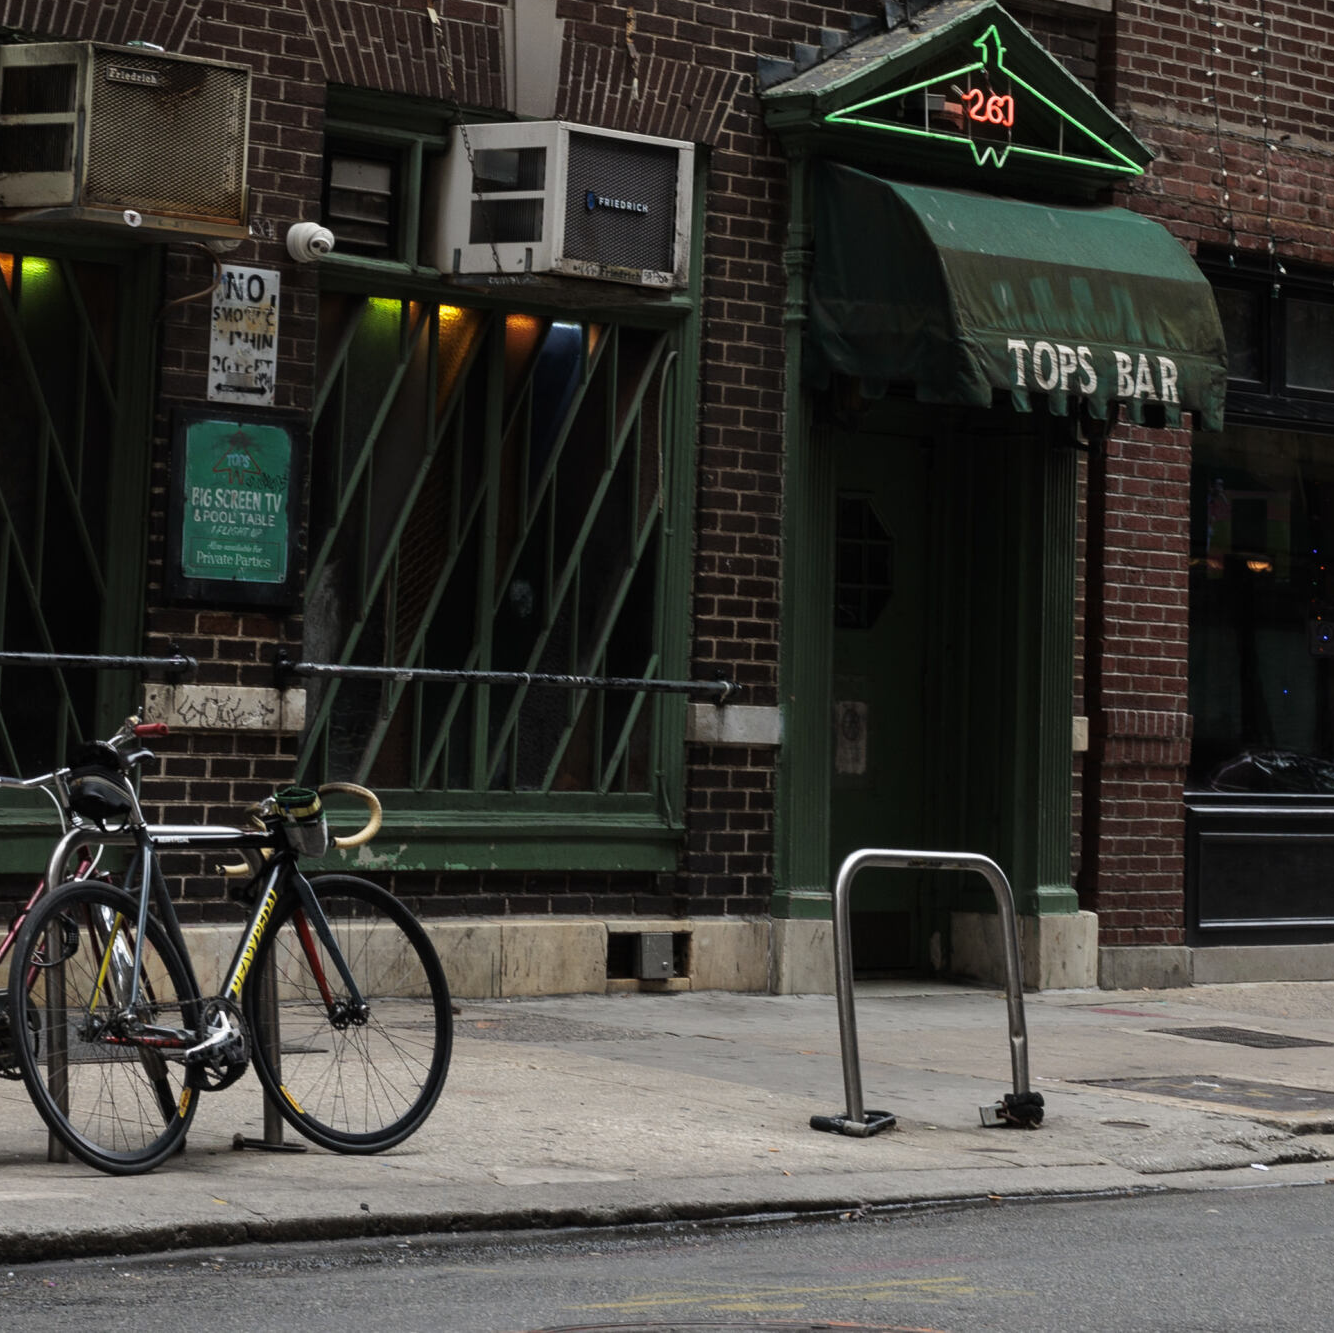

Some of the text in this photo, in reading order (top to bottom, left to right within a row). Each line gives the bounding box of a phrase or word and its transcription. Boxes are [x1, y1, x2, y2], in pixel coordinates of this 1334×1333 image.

[598, 197, 649, 213] FRIEDRICH
[226, 271, 265, 303] NO
[1006, 337, 1181, 405] TOPS BAR
[227, 453, 251, 468] TOPS
[191, 486, 282, 513] BIG SCREEN TV
[193, 508, 276, 528] & POOL TABLE
[250, 528, 263, 539] UP
[196, 550, 272, 568] Private Parties
